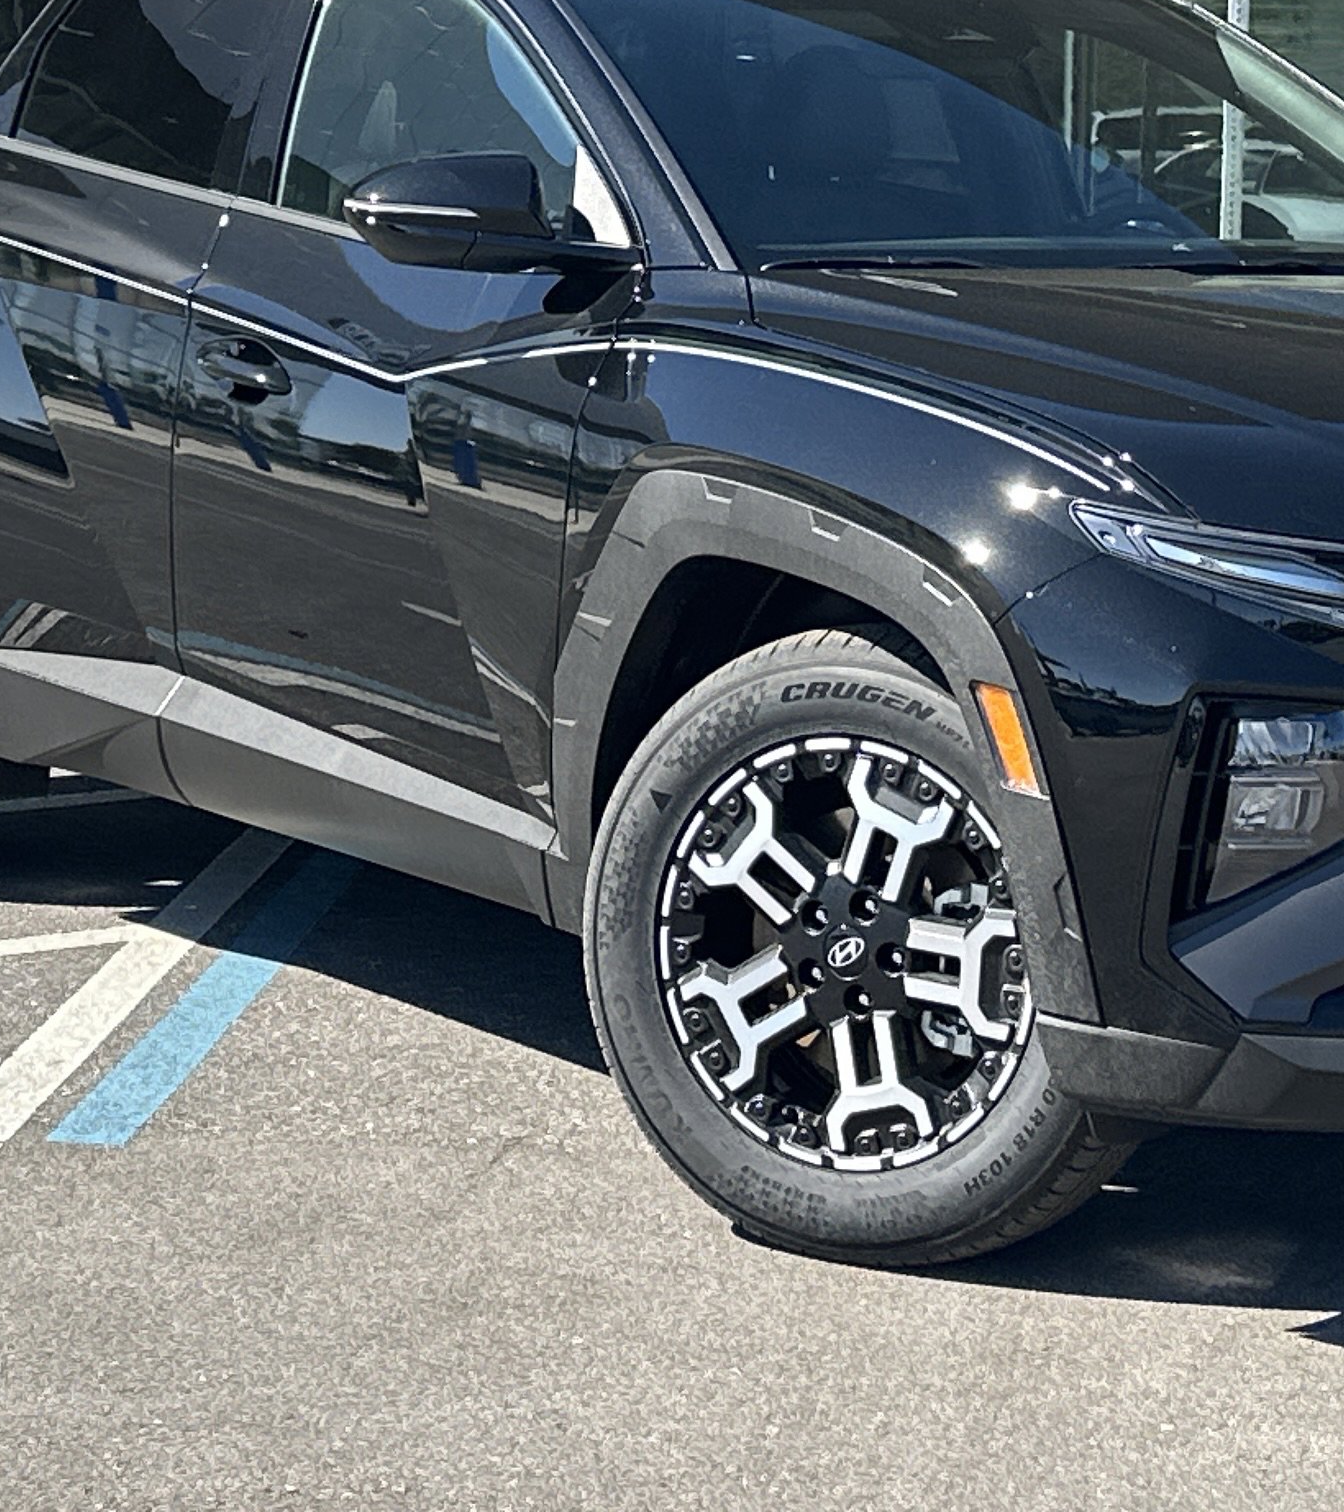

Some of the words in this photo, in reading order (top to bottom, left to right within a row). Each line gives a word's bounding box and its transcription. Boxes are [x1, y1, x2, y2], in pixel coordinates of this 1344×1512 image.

[780, 681, 936, 722] CRUGEN
[1013, 1107, 1047, 1152] R18
[963, 1151, 1013, 1198] 103H
